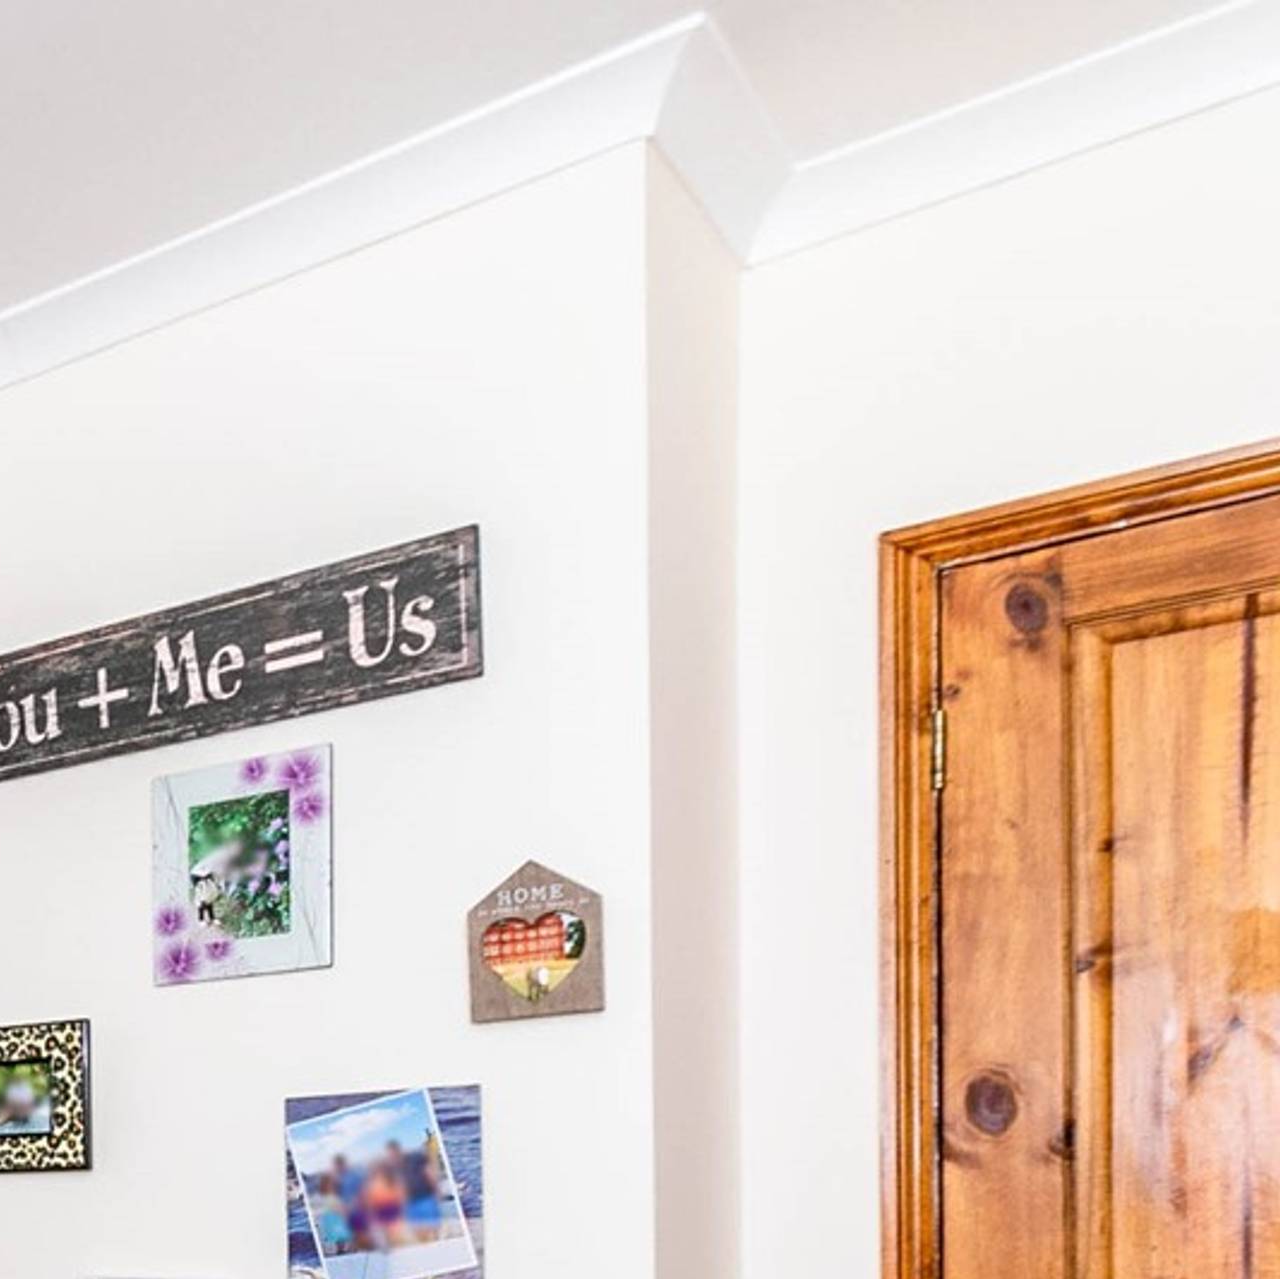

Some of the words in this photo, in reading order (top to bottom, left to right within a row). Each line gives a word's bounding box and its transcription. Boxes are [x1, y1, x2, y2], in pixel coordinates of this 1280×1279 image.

[147, 630, 246, 717] Me
[342, 577, 438, 668] Us
[496, 883, 564, 906] HOME
